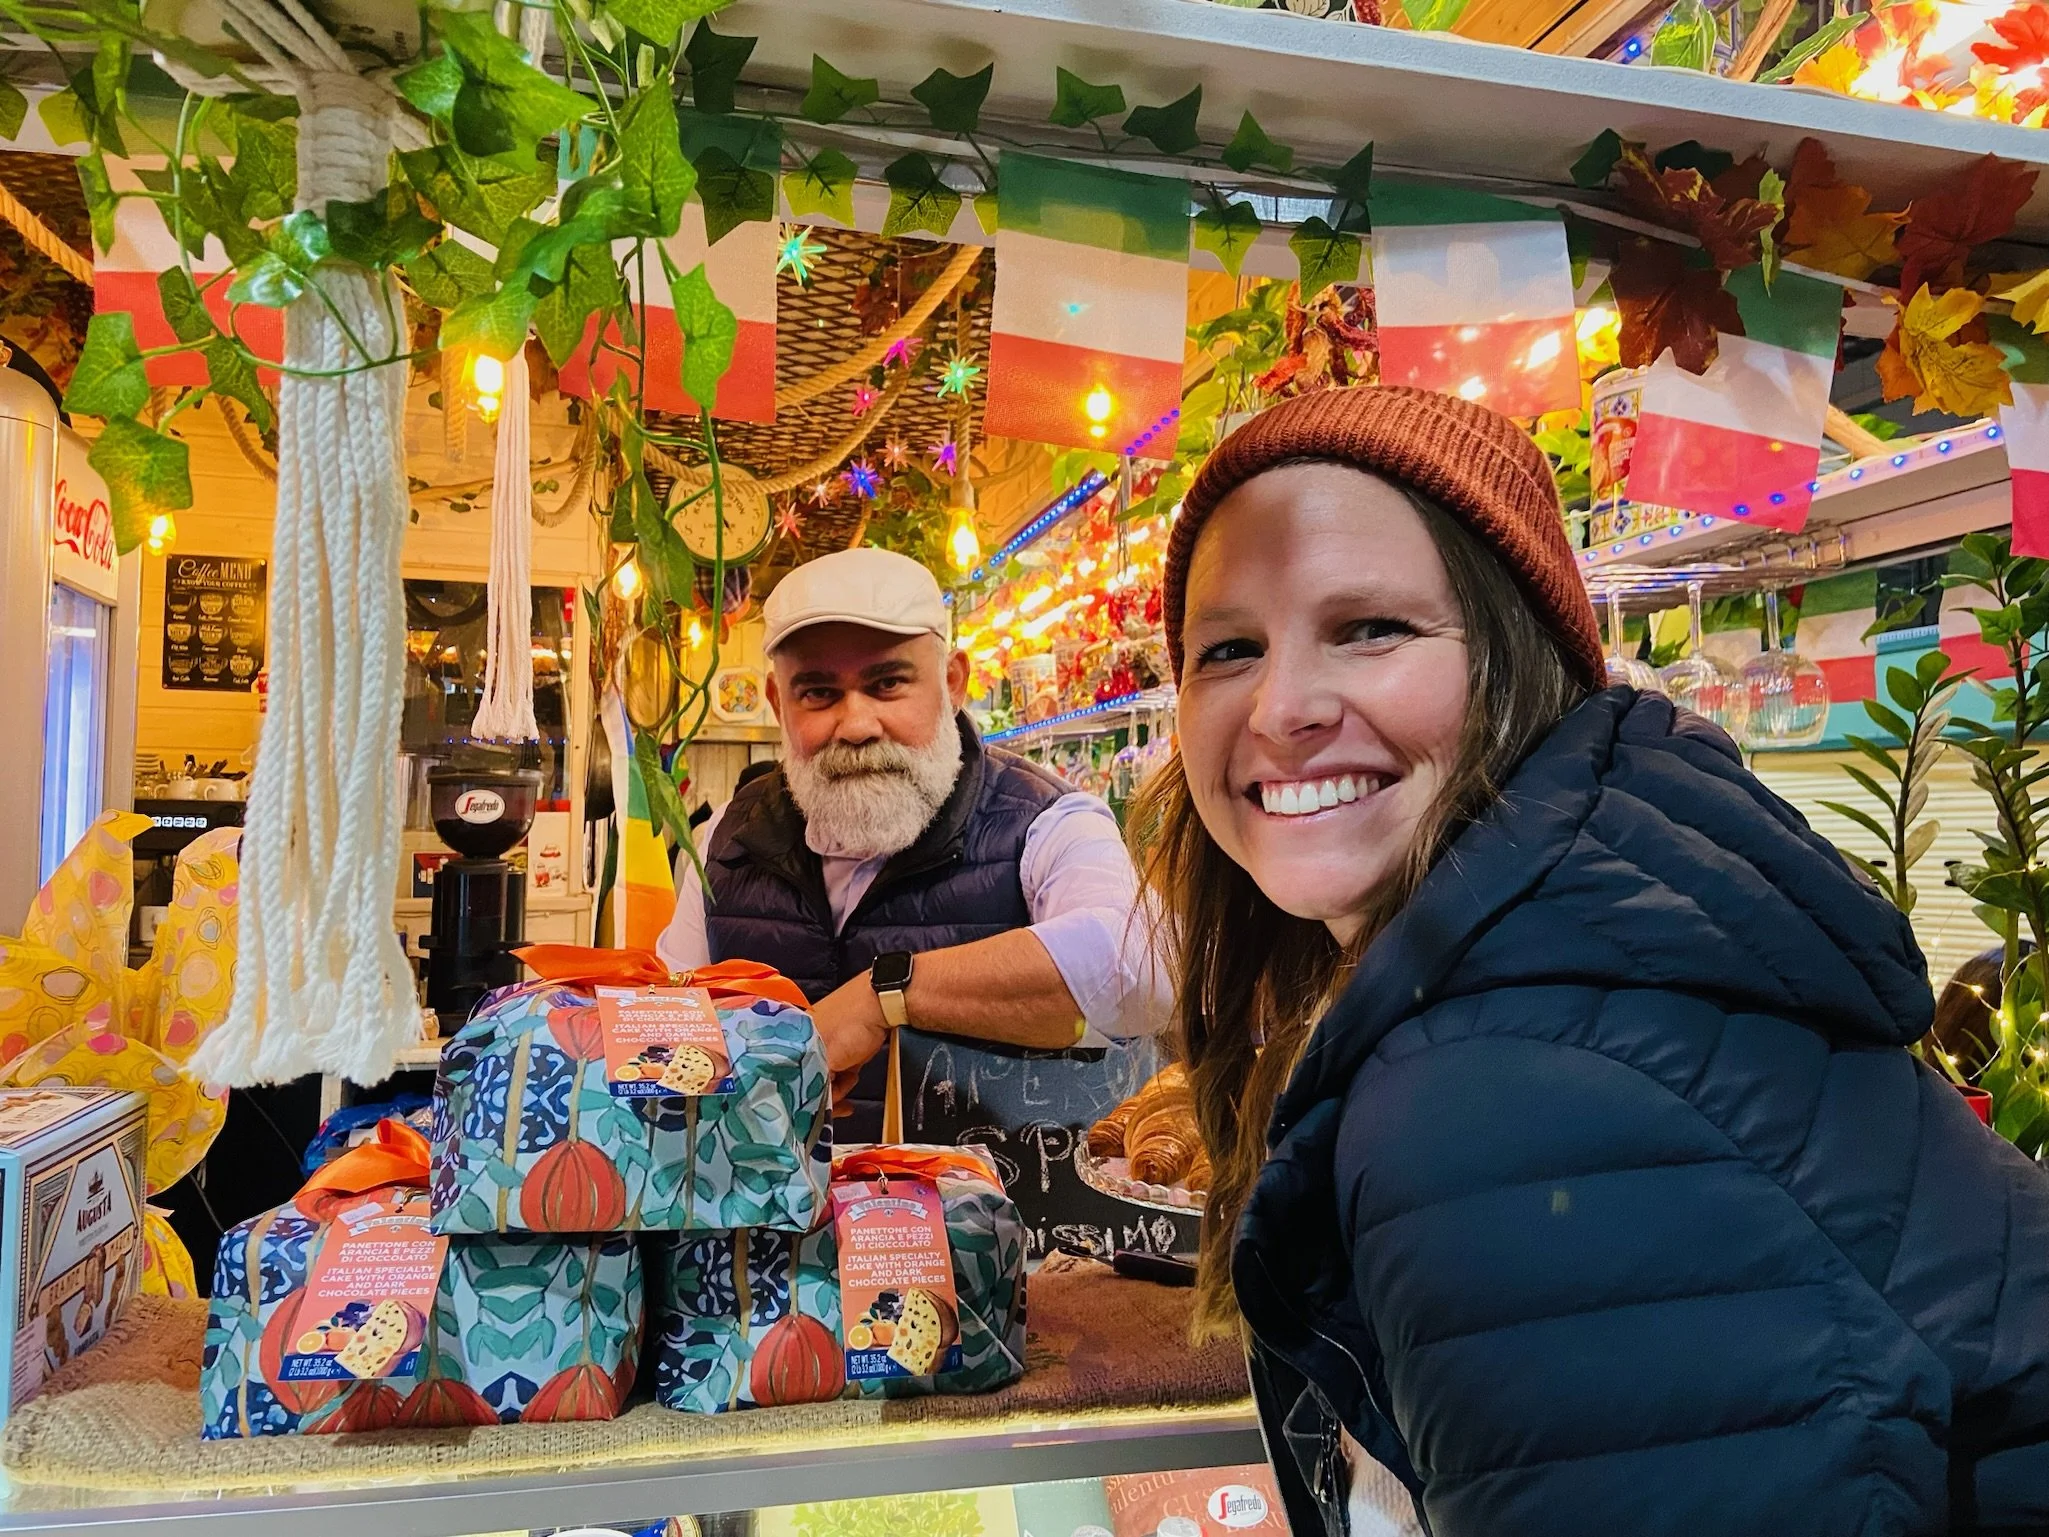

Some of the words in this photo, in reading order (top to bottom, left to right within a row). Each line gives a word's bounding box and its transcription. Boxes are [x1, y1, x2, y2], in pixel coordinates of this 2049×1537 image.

[178, 559, 219, 584] Coffee
[220, 561, 252, 581] MENU
[221, 581, 248, 589] COFFEE
[461, 797, 499, 814] Segafredo
[77, 1190, 111, 1235] AUGUSTA
[850, 1227, 908, 1235] PANETTONE
[850, 1234, 895, 1242] ARANCIA
[342, 1241, 409, 1249] PANETTONE
[868, 1240, 931, 1249] CIOCCOLATO
[339, 1248, 390, 1256] ARANCIA
[356, 1254, 429, 1263] CIOCCOLATO
[848, 1254, 887, 1263] ITALIAN
[889, 1252, 941, 1261] SPECIALTY
[375, 1265, 434, 1274] SPECIALTY
[845, 1262, 872, 1271] CAKE
[875, 1261, 901, 1269] WITH
[904, 1260, 945, 1268] ORANGE
[320, 1275, 353, 1283] CAKE
[388, 1272, 437, 1280] ORANGE
[871, 1270, 892, 1278] AND
[895, 1268, 922, 1276] DARK
[346, 1281, 371, 1289] AND
[374, 1281, 406, 1289] DARK
[848, 1277, 909, 1287] CHOCOLATE
[911, 1275, 946, 1284] PIECES
[318, 1289, 387, 1297] CHOCOLATE
[390, 1287, 430, 1295] PIECES
[1218, 1492, 1262, 1520] Segafredo
